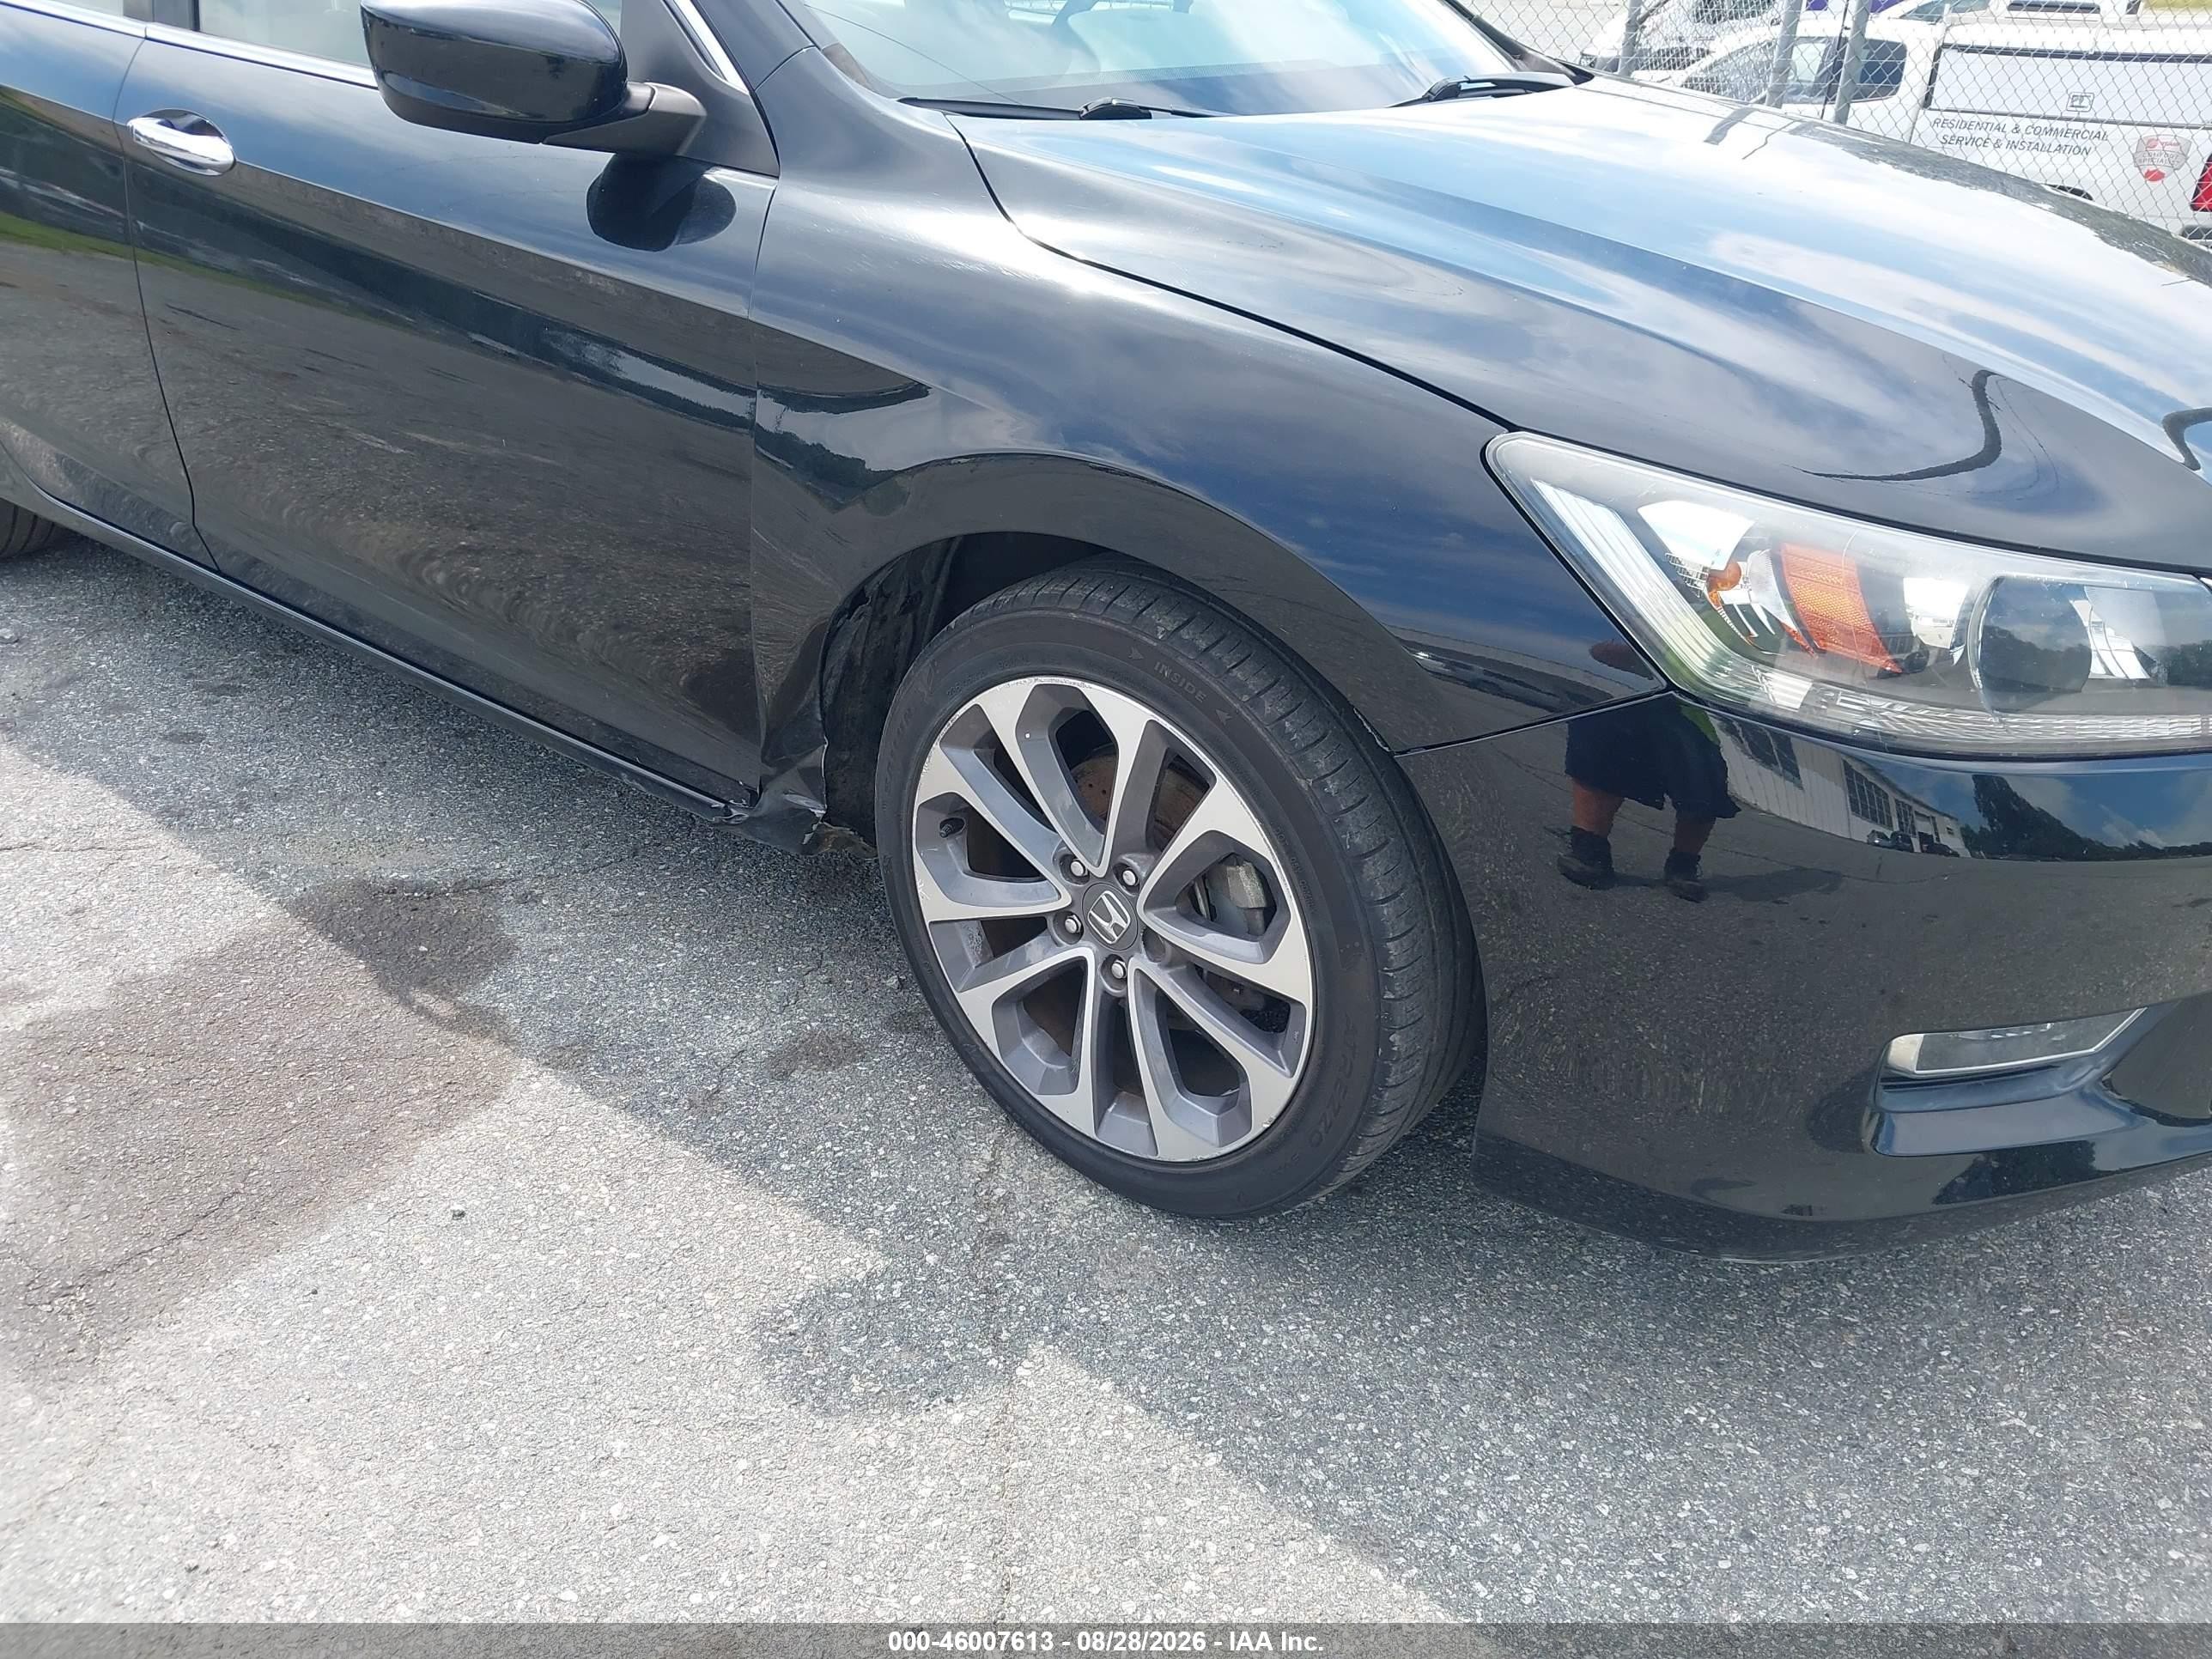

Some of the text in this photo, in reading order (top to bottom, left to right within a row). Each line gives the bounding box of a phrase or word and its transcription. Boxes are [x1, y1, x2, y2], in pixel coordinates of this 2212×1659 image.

[1932, 118, 2109, 141] RESIDENTIAL & COMMERCIAL
[1940, 134, 2092, 156] SERVICE & INSTALLATION
[1153, 660, 1207, 703] INSIDE
